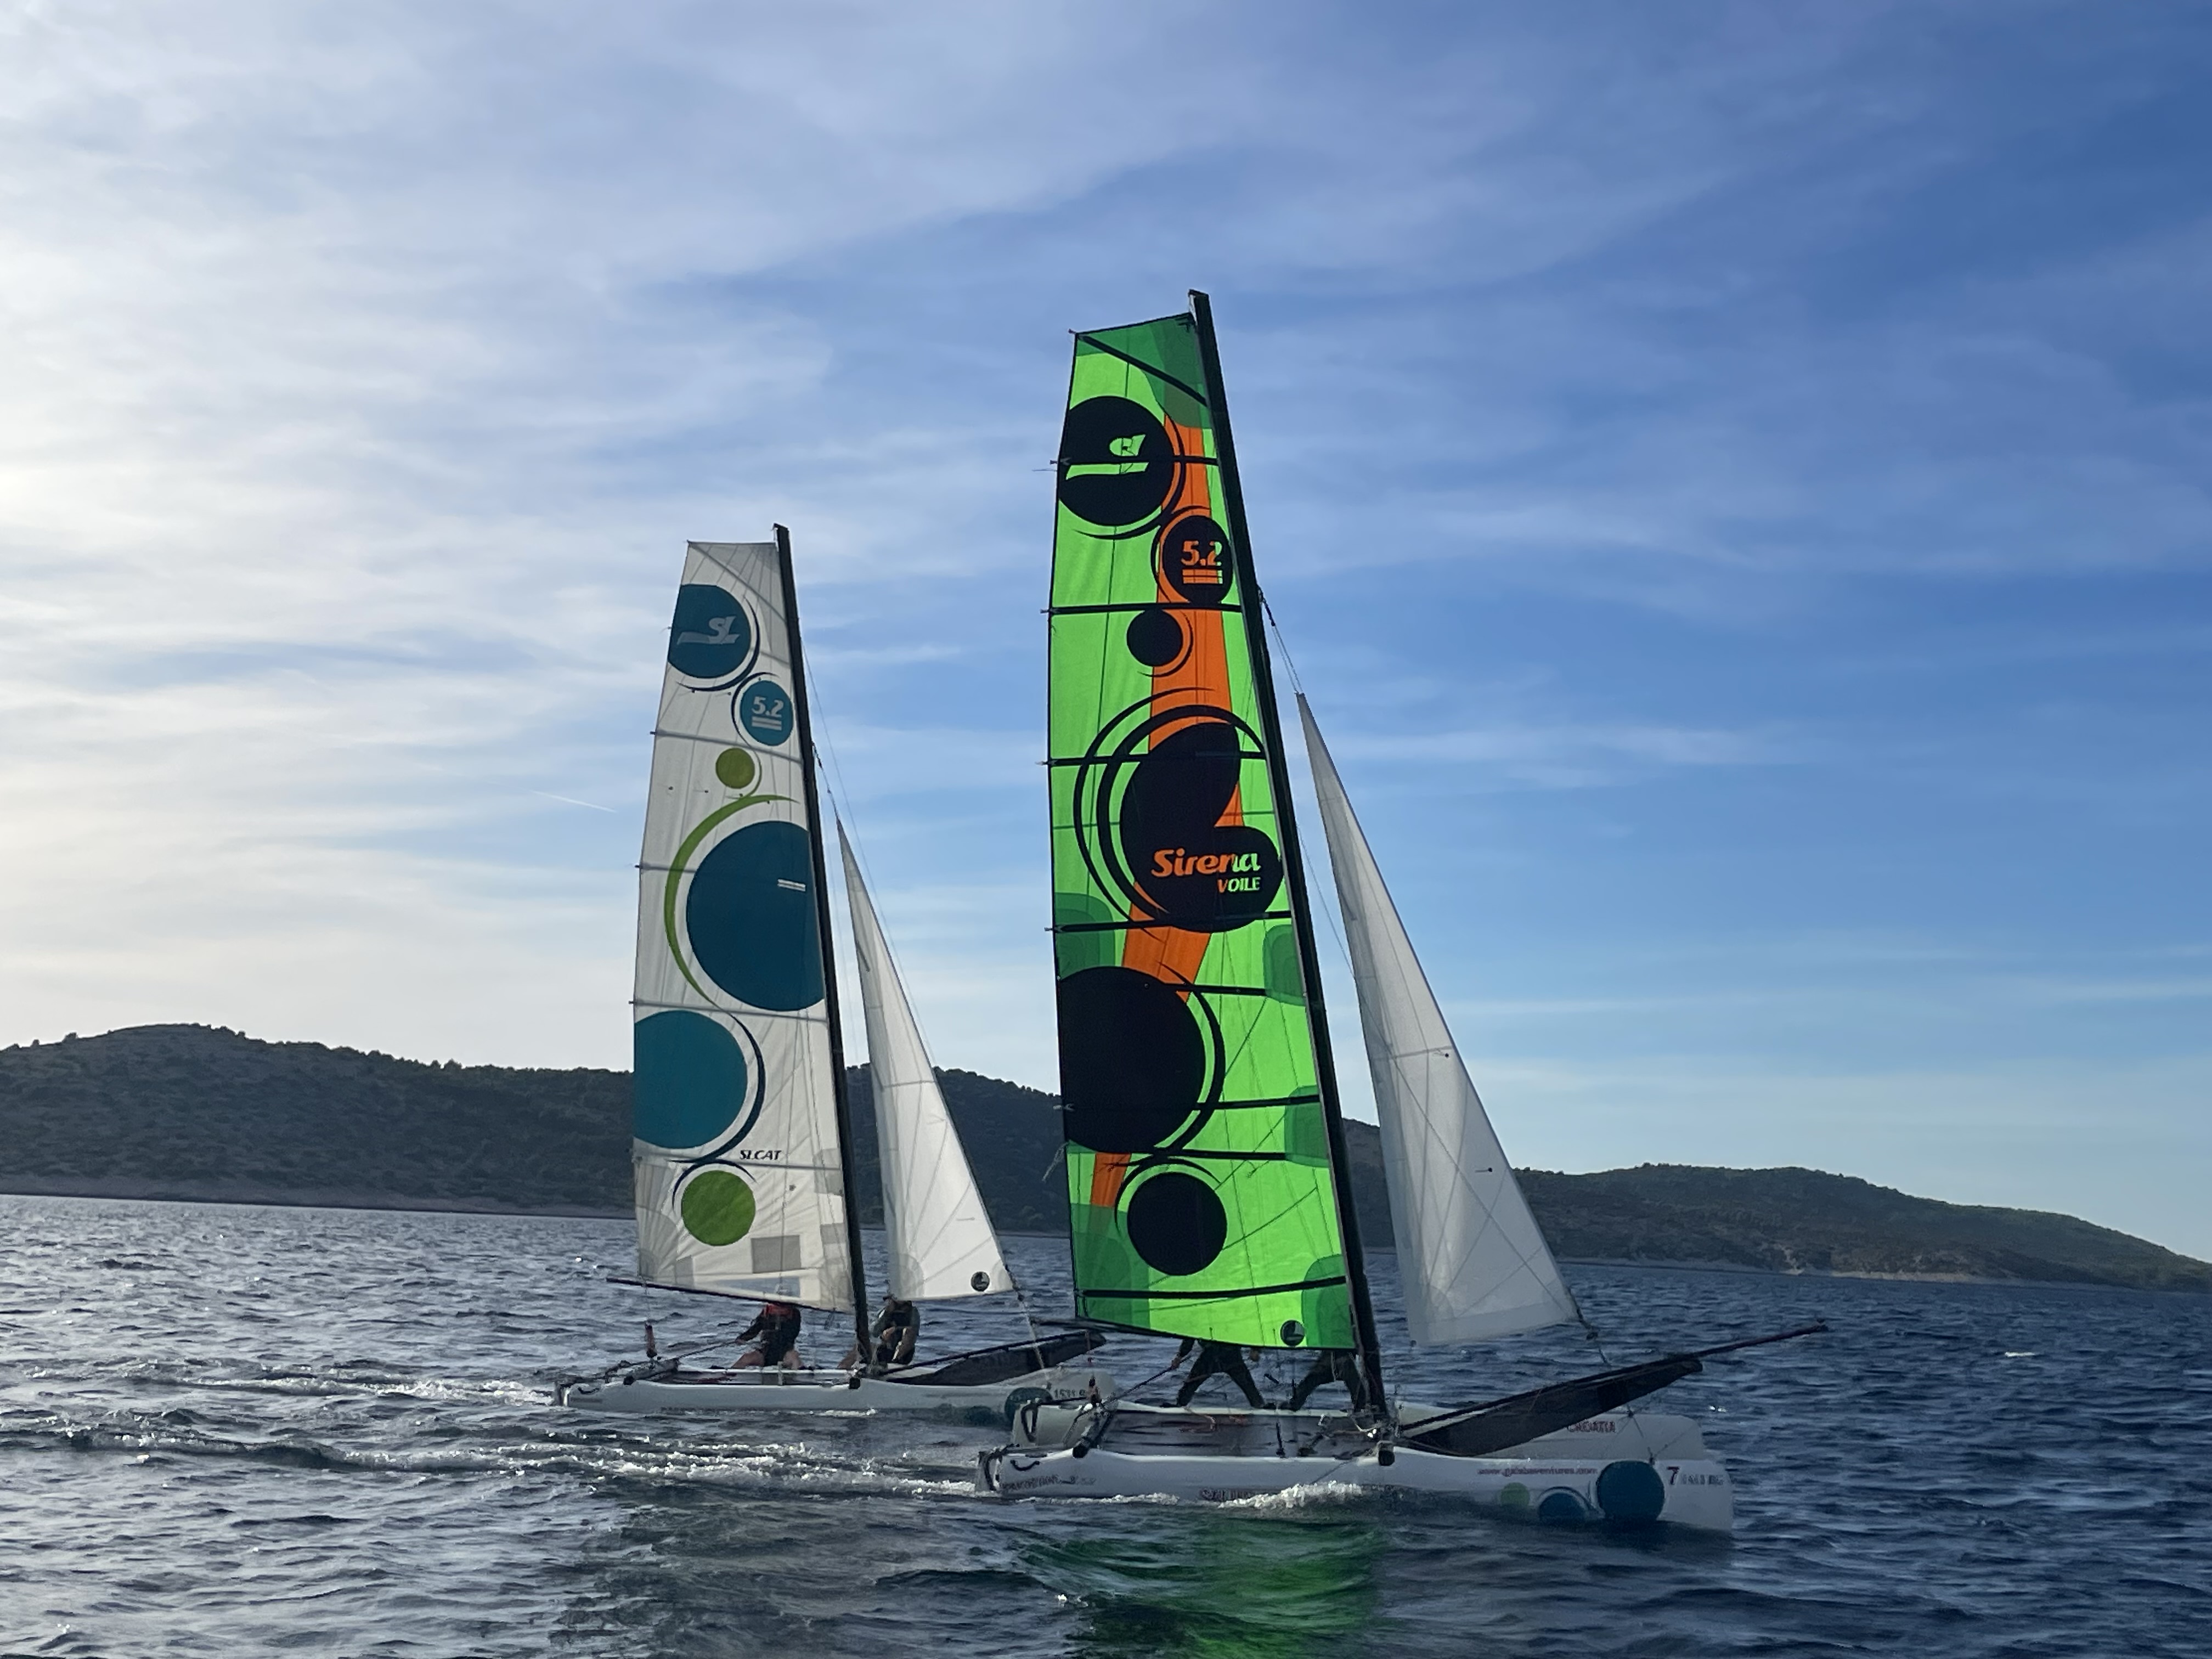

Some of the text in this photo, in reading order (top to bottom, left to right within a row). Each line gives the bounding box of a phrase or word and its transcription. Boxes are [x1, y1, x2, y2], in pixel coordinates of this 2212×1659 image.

[1181, 540, 1222, 566] 5.2
[751, 696, 784, 718] 5.2
[1150, 848, 1261, 877] Sirena
[1217, 877, 1261, 893] VOILE
[1666, 1466, 1680, 1486] 7
